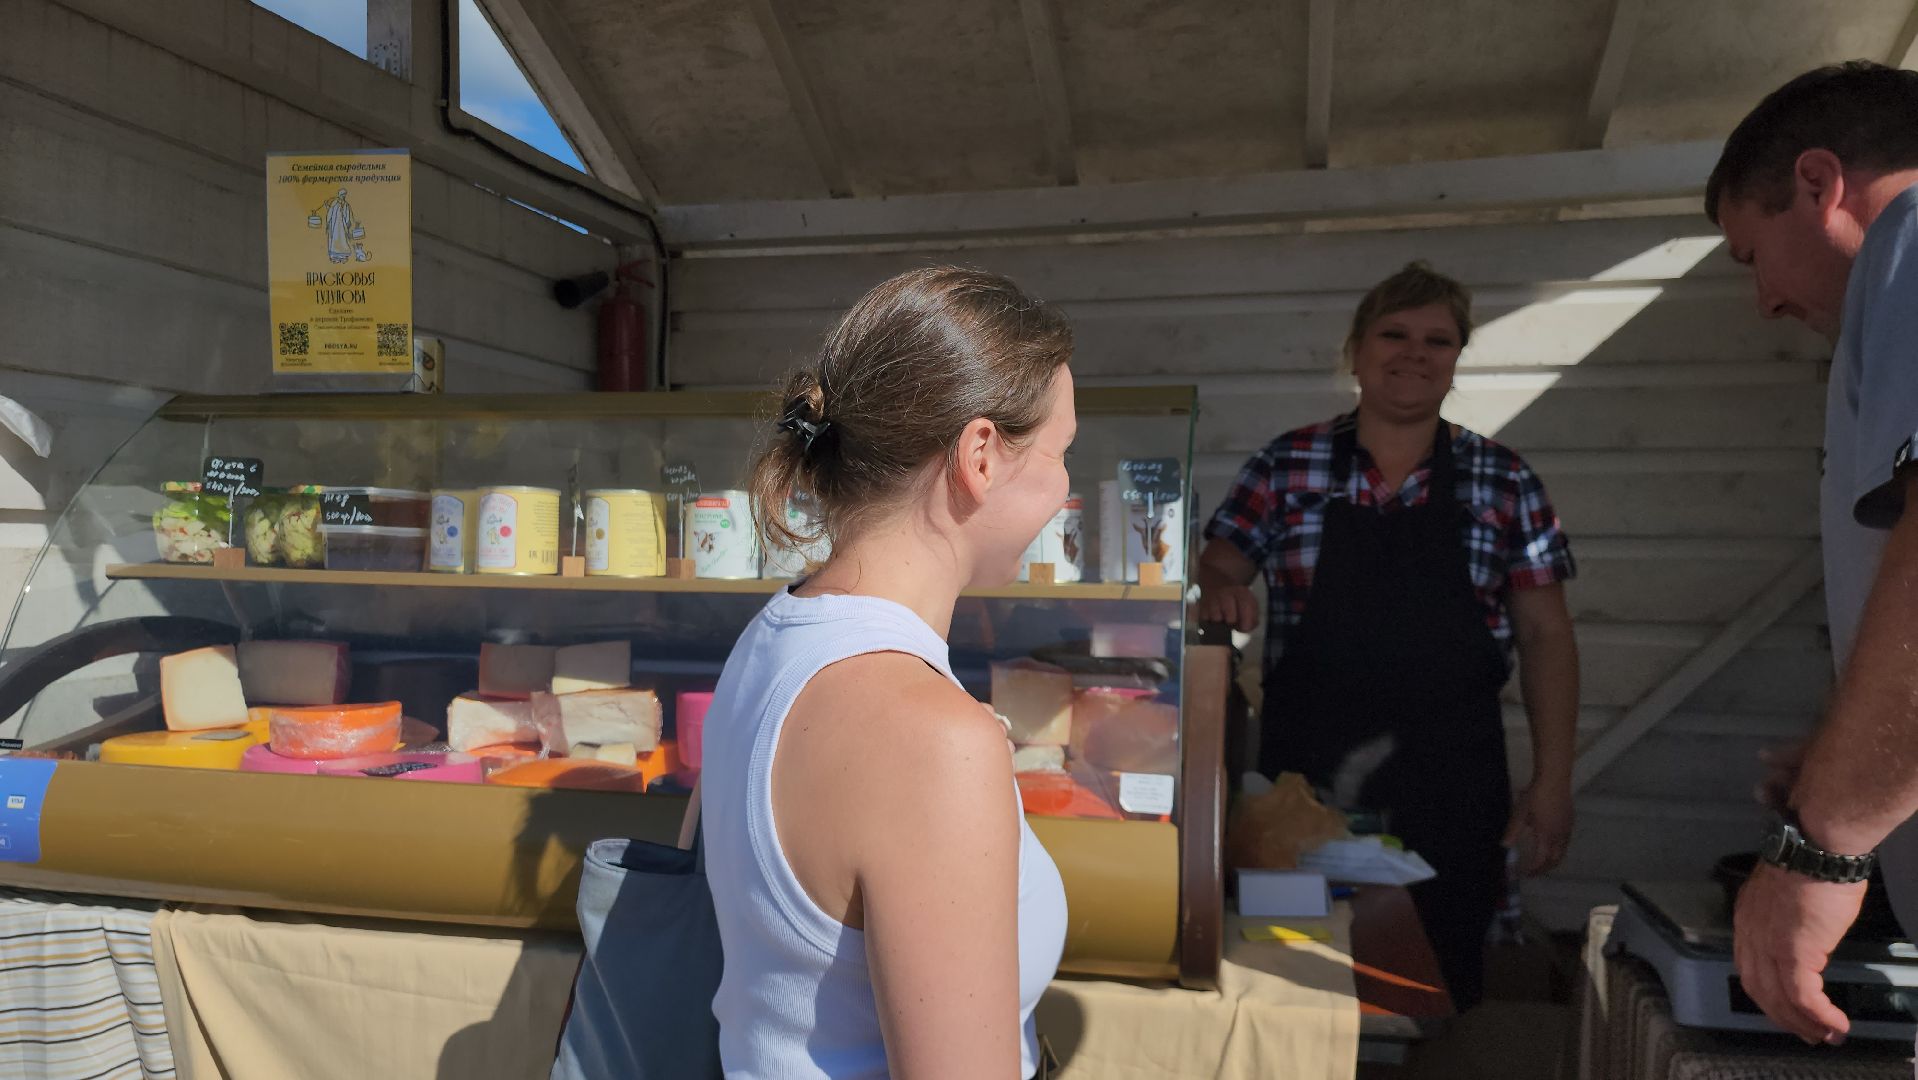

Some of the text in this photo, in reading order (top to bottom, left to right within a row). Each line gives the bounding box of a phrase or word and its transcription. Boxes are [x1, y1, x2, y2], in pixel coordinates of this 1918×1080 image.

[291, 162, 386, 174] Семейная сыродельня
[278, 172, 401, 185] 100% фермерская продукция
[306, 271, 375, 286] ПРАСКОВЬЯ
